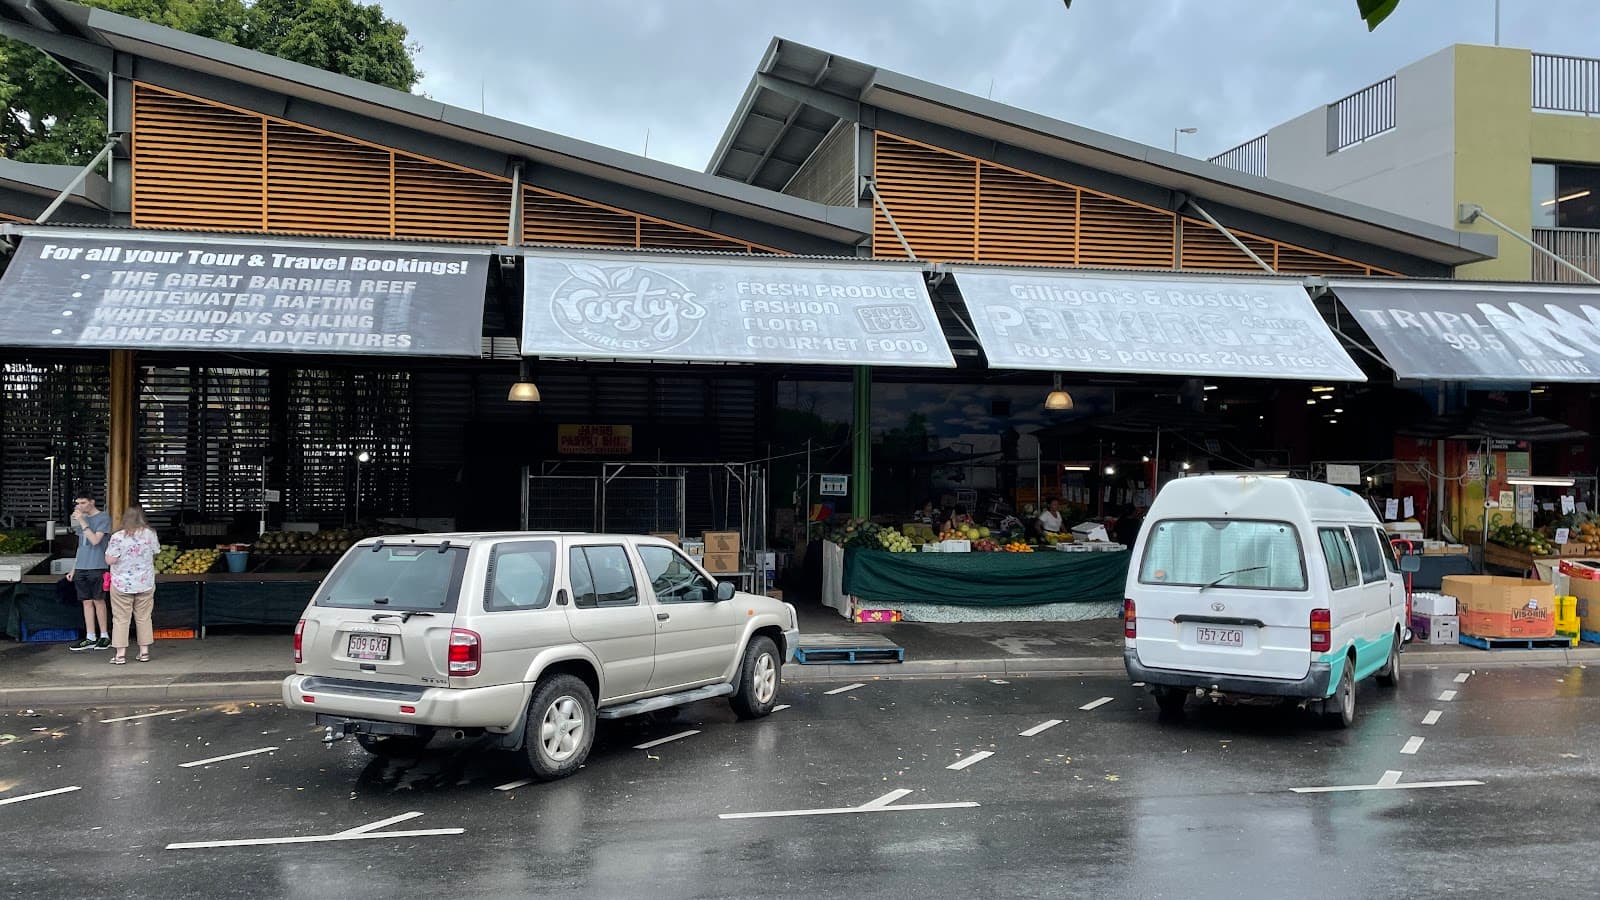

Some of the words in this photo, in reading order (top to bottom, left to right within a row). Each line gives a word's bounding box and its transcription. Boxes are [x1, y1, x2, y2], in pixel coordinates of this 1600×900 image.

[40, 244, 84, 261] For
[85, 245, 118, 262] all
[123, 248, 184, 266] your
[188, 249, 244, 267] Tour
[248, 251, 266, 268] &
[270, 253, 345, 271] Travel
[351, 256, 469, 275] Bookings!
[110, 270, 156, 287] THE
[166, 272, 243, 290] GREAT
[249, 275, 352, 293] BARRIER
[358, 279, 417, 295] REEF
[736, 282, 810, 297] FRESH
[815, 284, 918, 299] PRODUCE
[102, 289, 266, 308] WHITEWATER
[272, 293, 375, 311] RAFTING
[739, 300, 841, 315] FASHION
[1142, 290, 1161, 305] &
[1166, 290, 1269, 311] Rusty's
[94, 307, 273, 326] WHITSUNDAYS
[280, 312, 375, 329] SAILING
[743, 317, 819, 332] FLORA
[984, 304, 1241, 347] PARKING
[81, 325, 245, 344] RAINFOREST
[250, 329, 413, 347] ADVENTURES
[577, 328, 651, 348] MARKETS
[866, 339, 929, 353] FOOD
[1443, 331, 1504, 352] 99.5
[1014, 342, 1112, 362] Rusty's
[1116, 348, 1213, 365] patrons
[1216, 351, 1274, 366] 2hrs
[1275, 352, 1330, 368] free
[1518, 358, 1592, 374] CAIRNS
[351, 636, 367, 650] 509
[369, 638, 388, 652] GXB
[1199, 629, 1216, 640] 757
[1220, 631, 1241, 643] ZCQ
